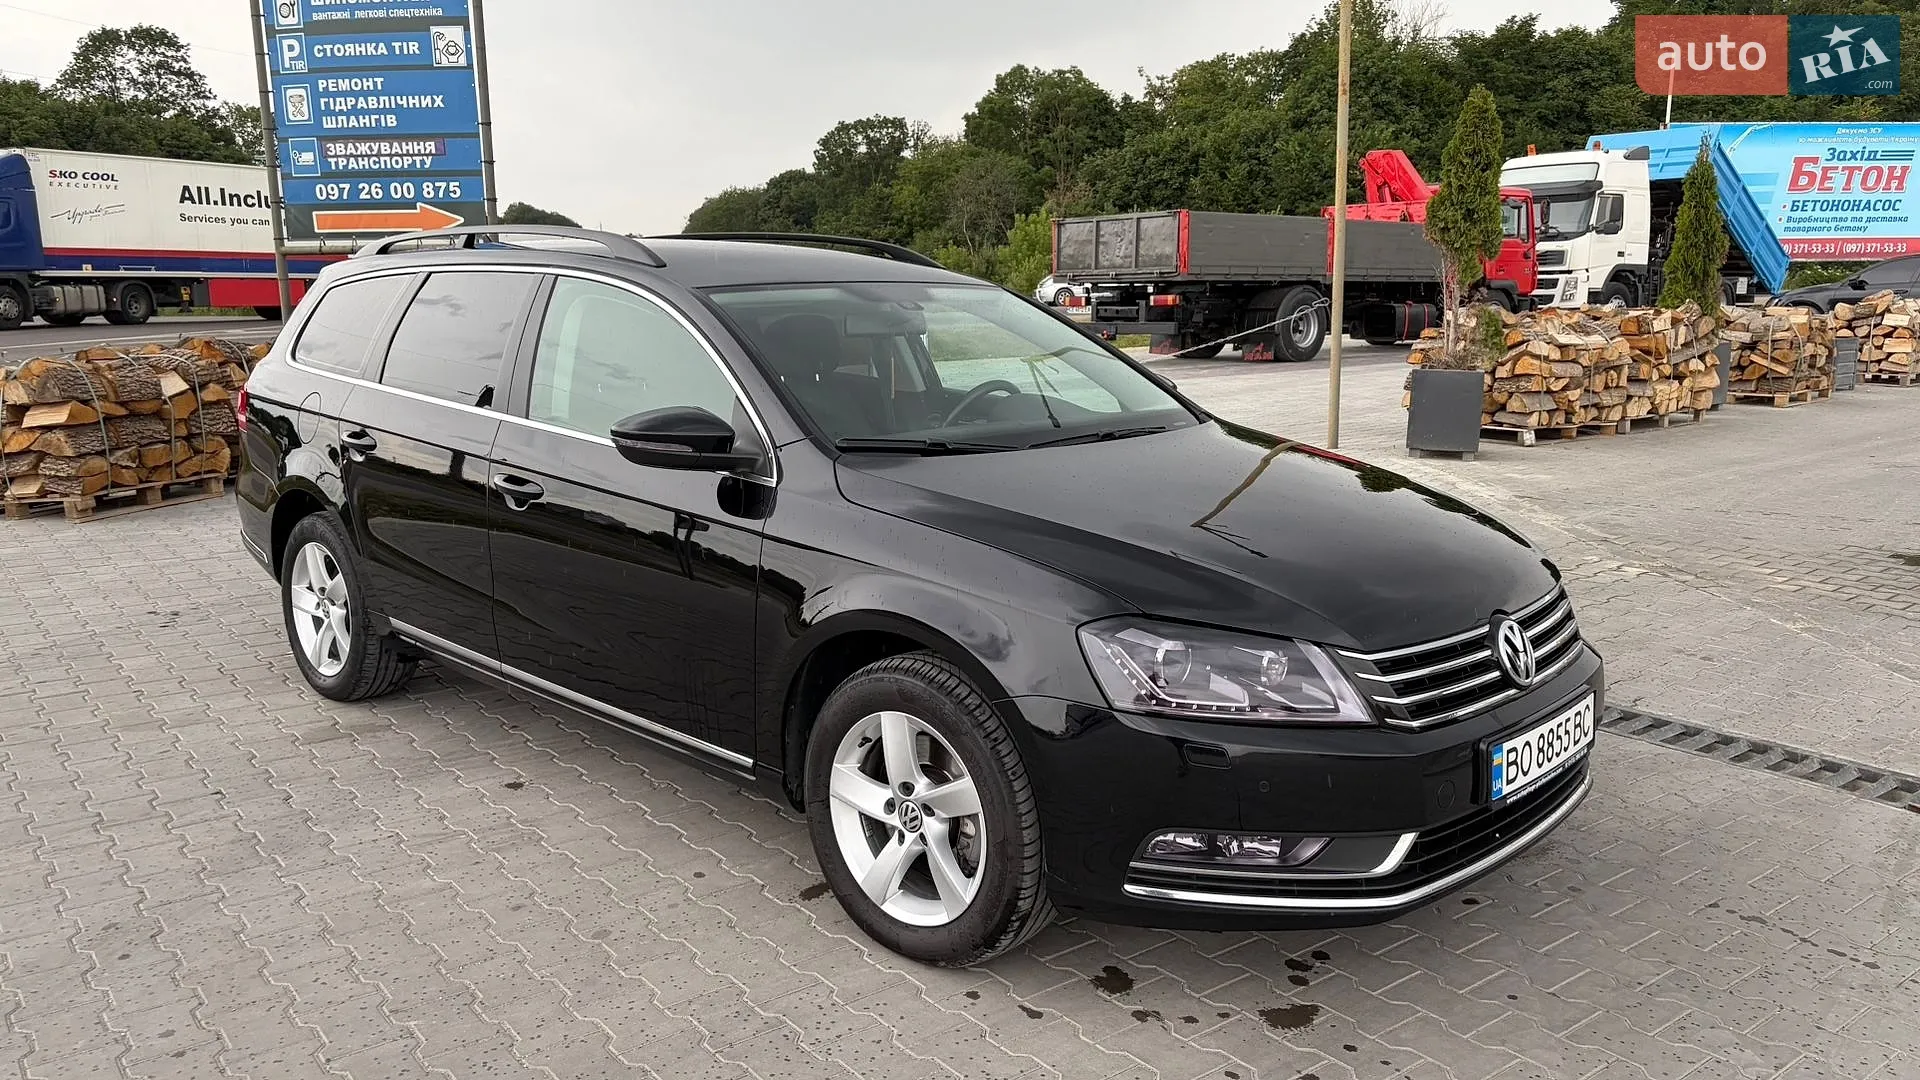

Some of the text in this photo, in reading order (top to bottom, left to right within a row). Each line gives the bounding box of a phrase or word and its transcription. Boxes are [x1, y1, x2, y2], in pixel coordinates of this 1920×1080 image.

[312, 6, 443, 21] вантажні легкові спецтехніка
[313, 41, 421, 58] СТОЯНКА TIR
[290, 60, 306, 71] TIR
[318, 77, 384, 92] РЕМОНТ
[320, 95, 445, 111] ГІДРАВЛІЧНИХ
[322, 115, 398, 129] ШЛАНГІВ
[326, 141, 436, 156] ЗВАЖУВАННЯ
[1825, 146, 1880, 161] Захід
[328, 156, 434, 171] ТРАНСПОРТУ
[48, 169, 119, 182] S.KO COOL
[1787, 156, 1911, 193] БЕТОН
[49, 181, 119, 190] EXECUTIVE
[315, 181, 461, 200] 097 26 00 875
[1790, 199, 1902, 212] БЕТОНОНАСОС
[180, 213, 270, 227] Services you can
[1786, 215, 1849, 224] Виробництво
[1865, 215, 1909, 224] доставка
[1783, 225, 1869, 234] товарного бетону
[1793, 243, 1835, 253] 371-53-33
[1843, 242, 1865, 254] (097)
[1865, 242, 1907, 253] 371-53-33
[1506, 741, 1532, 787] BO
[1536, 717, 1571, 769] 8855
[1573, 704, 1591, 748] BC
[1493, 779, 1503, 791] UA
